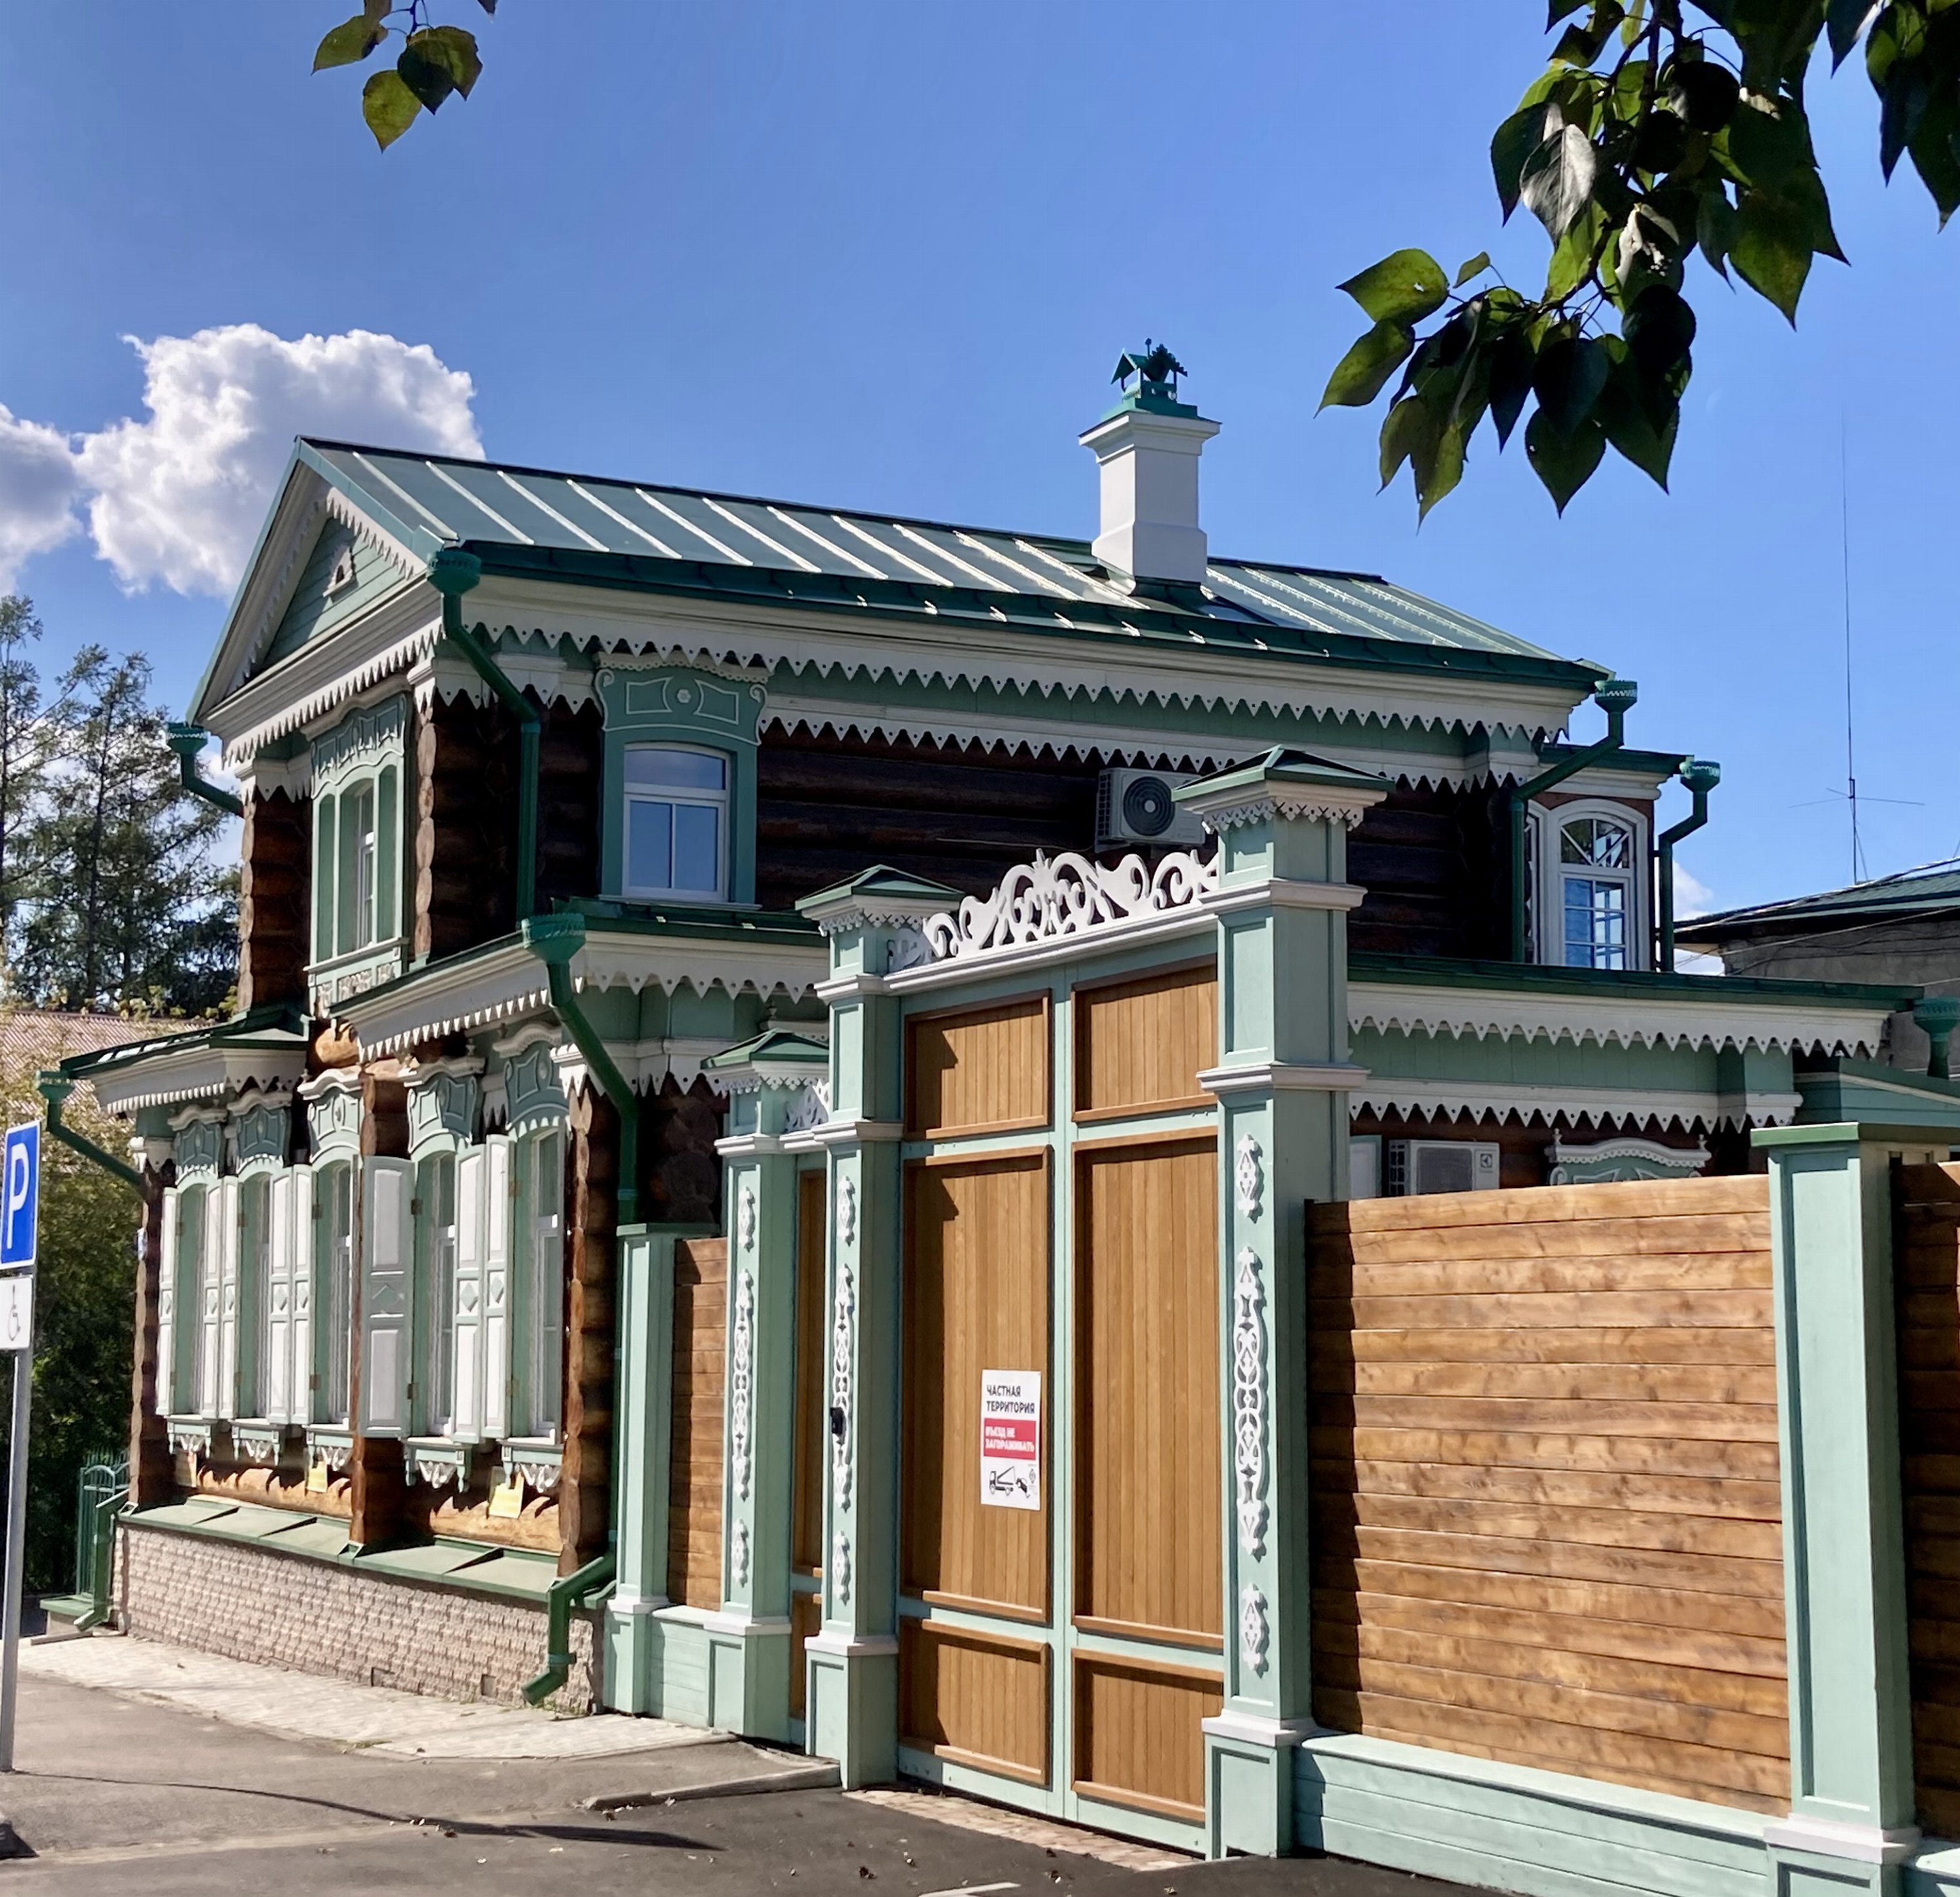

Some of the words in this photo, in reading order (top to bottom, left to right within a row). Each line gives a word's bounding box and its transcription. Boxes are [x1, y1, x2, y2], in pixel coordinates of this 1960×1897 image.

[7, 1143, 29, 1249] P
[987, 1384, 1021, 1397] ЧАСТНАЯ
[987, 1401, 1035, 1414] ТЕРРИТОРИЯ
